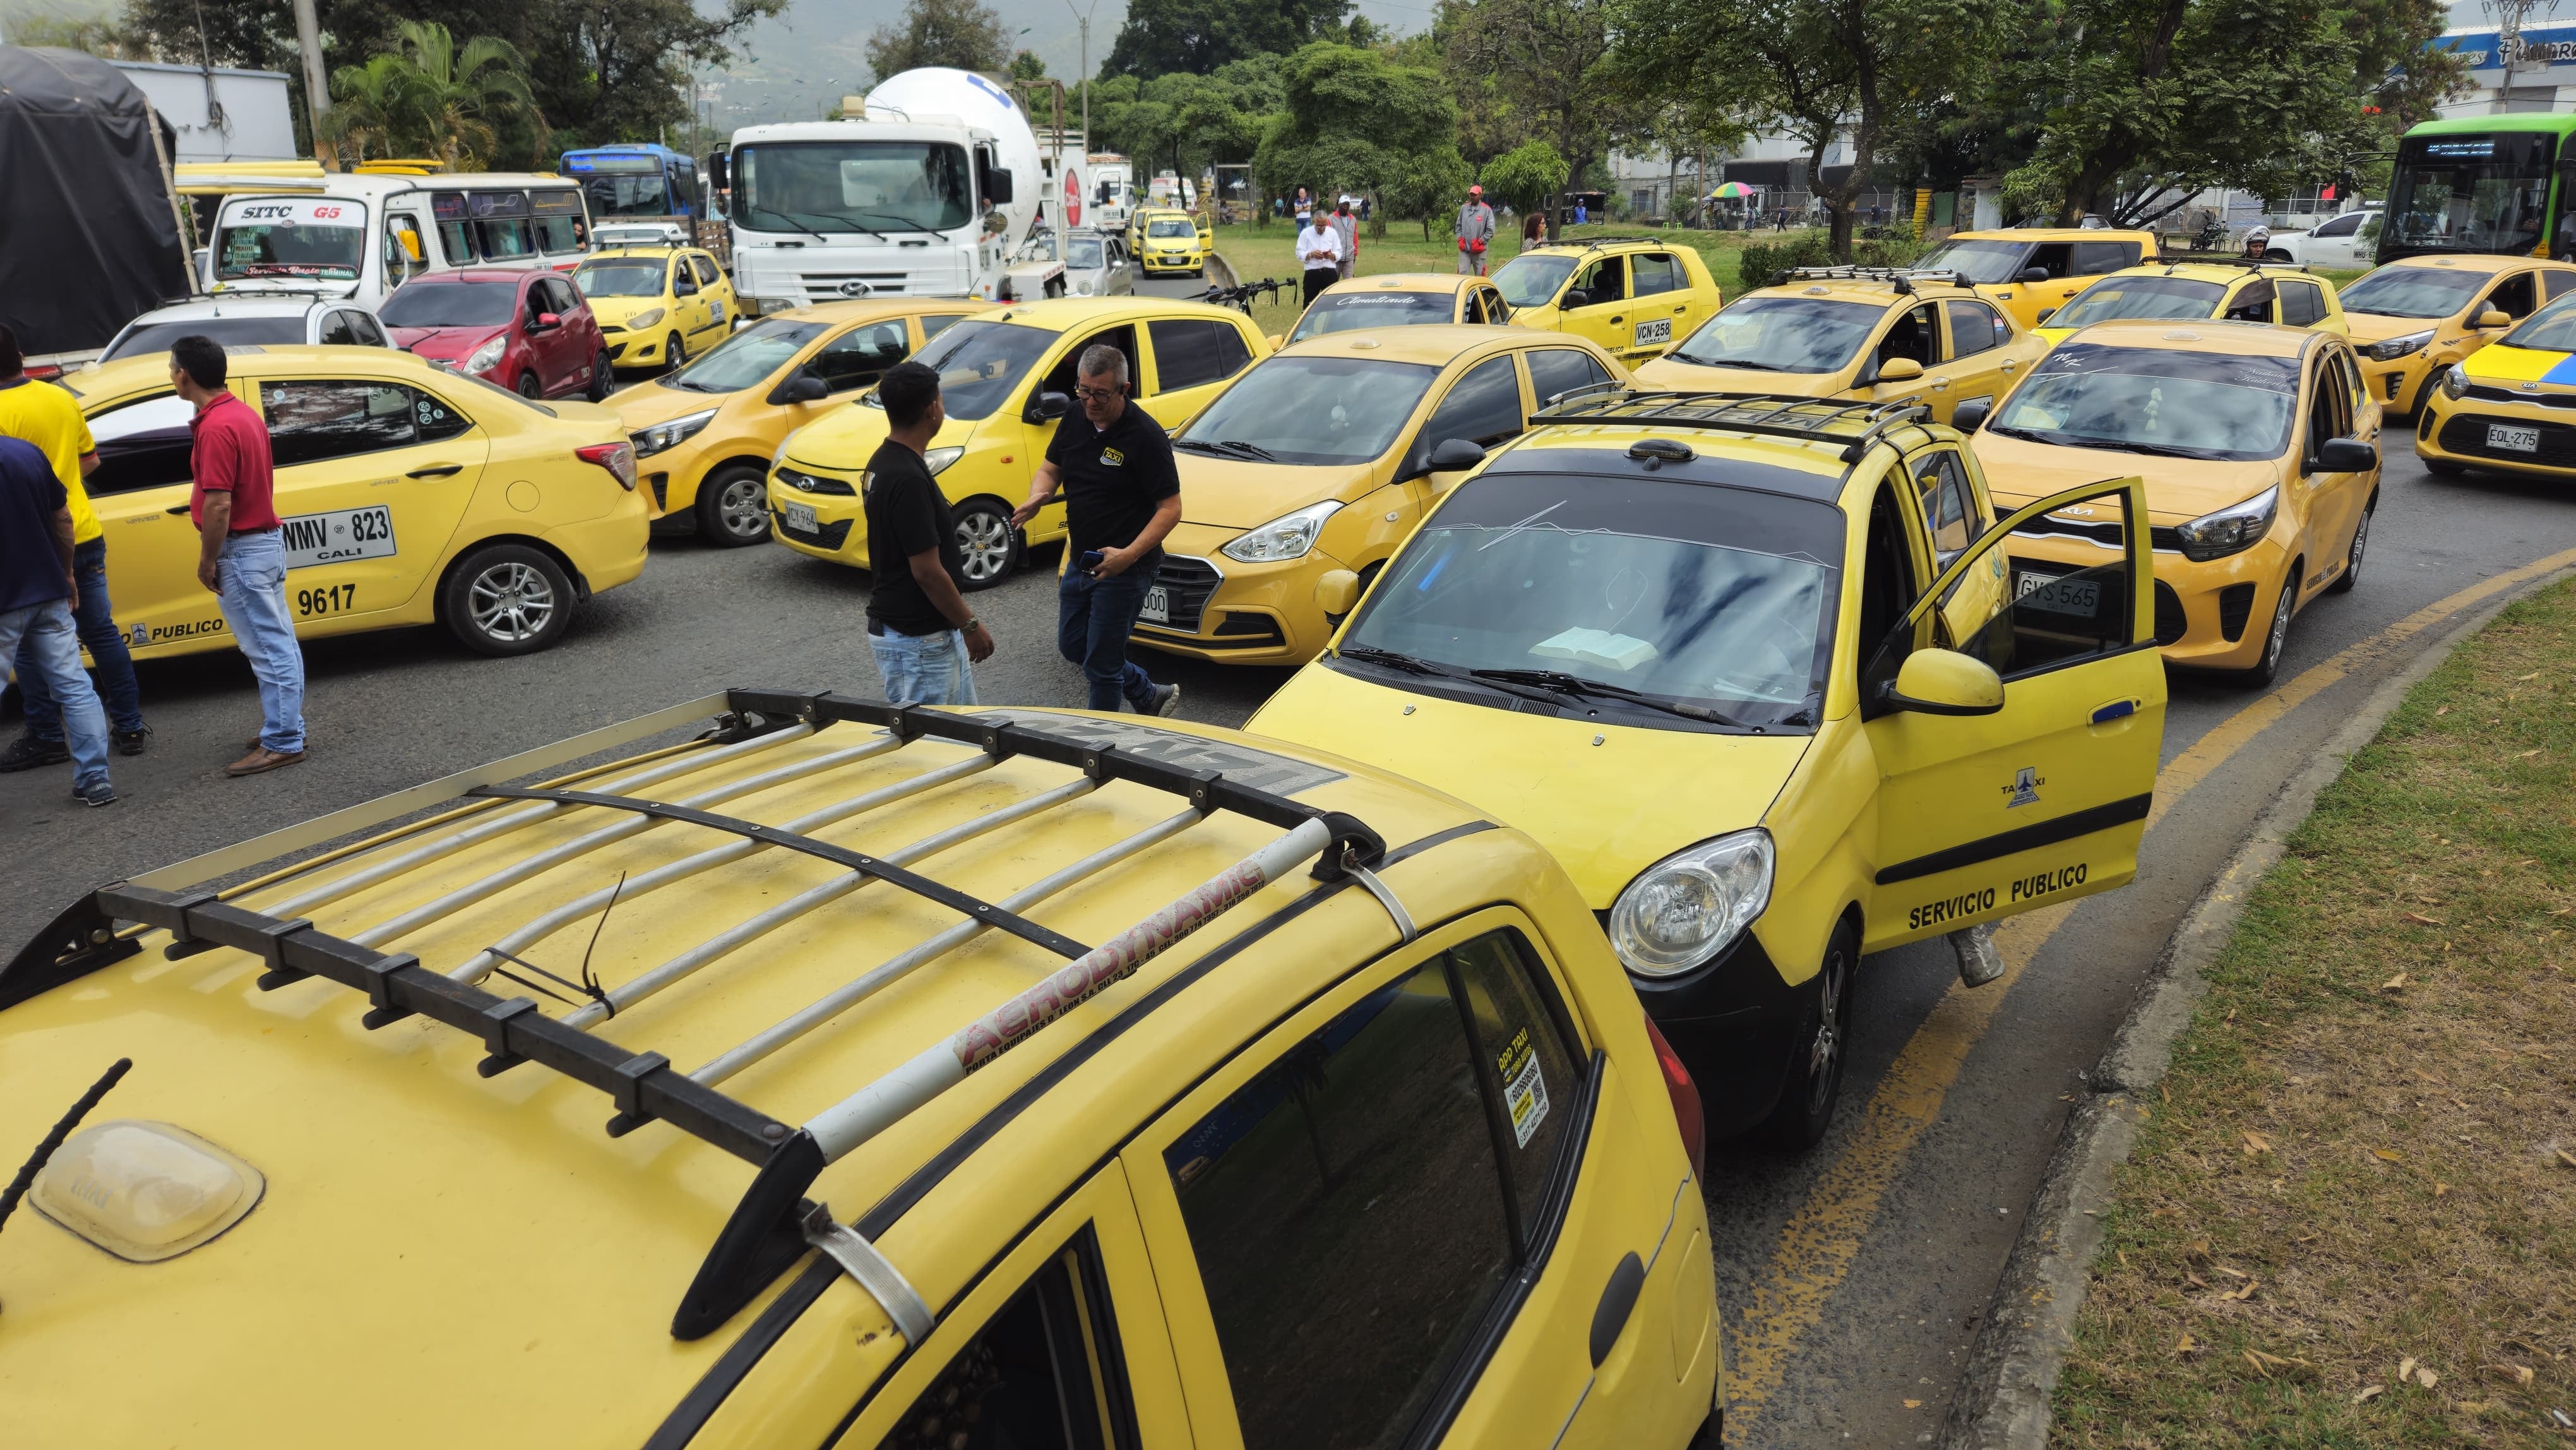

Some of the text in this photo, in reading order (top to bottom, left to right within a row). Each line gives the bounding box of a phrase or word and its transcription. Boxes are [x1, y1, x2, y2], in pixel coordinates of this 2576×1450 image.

[241, 206, 342, 219] SITC G5
[1637, 322, 1670, 340] VCN 258
[2513, 432, 2536, 446] 275
[1106, 450, 1121, 462] TAXI
[352, 510, 389, 542] 823
[787, 506, 815, 527] VCY 964
[317, 548, 362, 560] CALI
[298, 584, 355, 616] 9617
[2022, 579, 2097, 607] GVS 565
[152, 618, 224, 640] PUBLICO
[1909, 863, 2087, 930] SERVICIO PUBLICO
[963, 860, 1261, 1066] AERODYNAMIC
[966, 1050, 997, 1076] PORTA
[999, 1021, 1046, 1054] EQUIPAJES
[1059, 1000, 1080, 1016] LEON
[1112, 971, 1123, 981] 23
[1145, 950, 1155, 961] 45
[1174, 930, 1189, 942] 300
[1190, 921, 1202, 932] 774
[1498, 1027, 1528, 1072] APP TAXI
[1512, 1044, 1532, 1075] TORO AUTOS
[1522, 1101, 1547, 1141] 317 4271710
